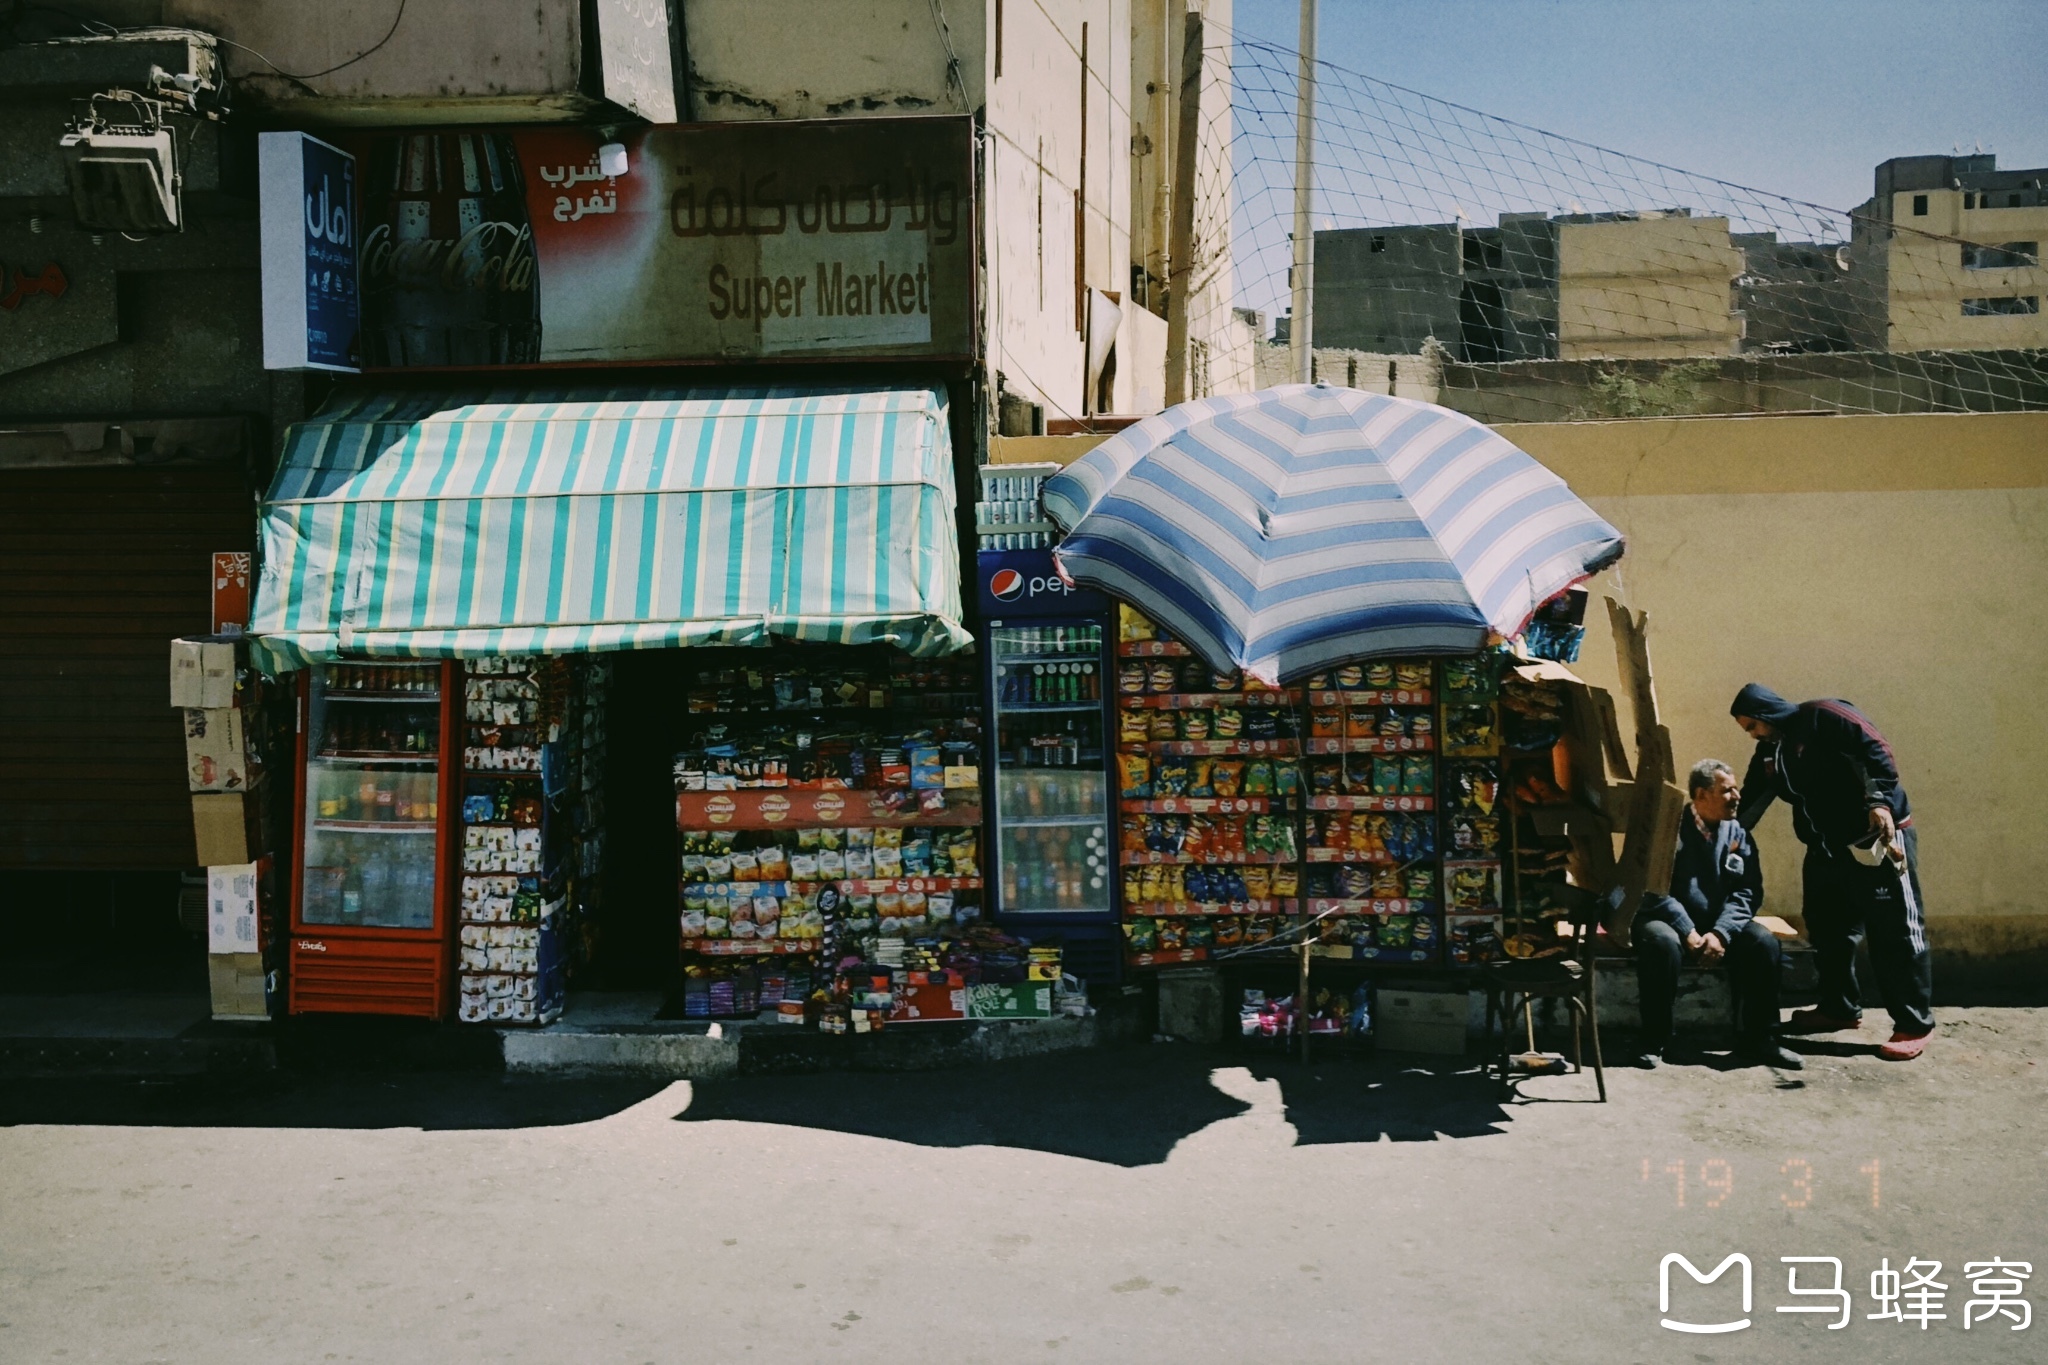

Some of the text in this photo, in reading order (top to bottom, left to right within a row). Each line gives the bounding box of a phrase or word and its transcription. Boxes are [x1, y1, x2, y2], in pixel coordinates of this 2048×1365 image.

[553, 189, 617, 222] تفرح
[359, 221, 533, 294] Coca-Cola
[708, 260, 928, 333] Super Market
